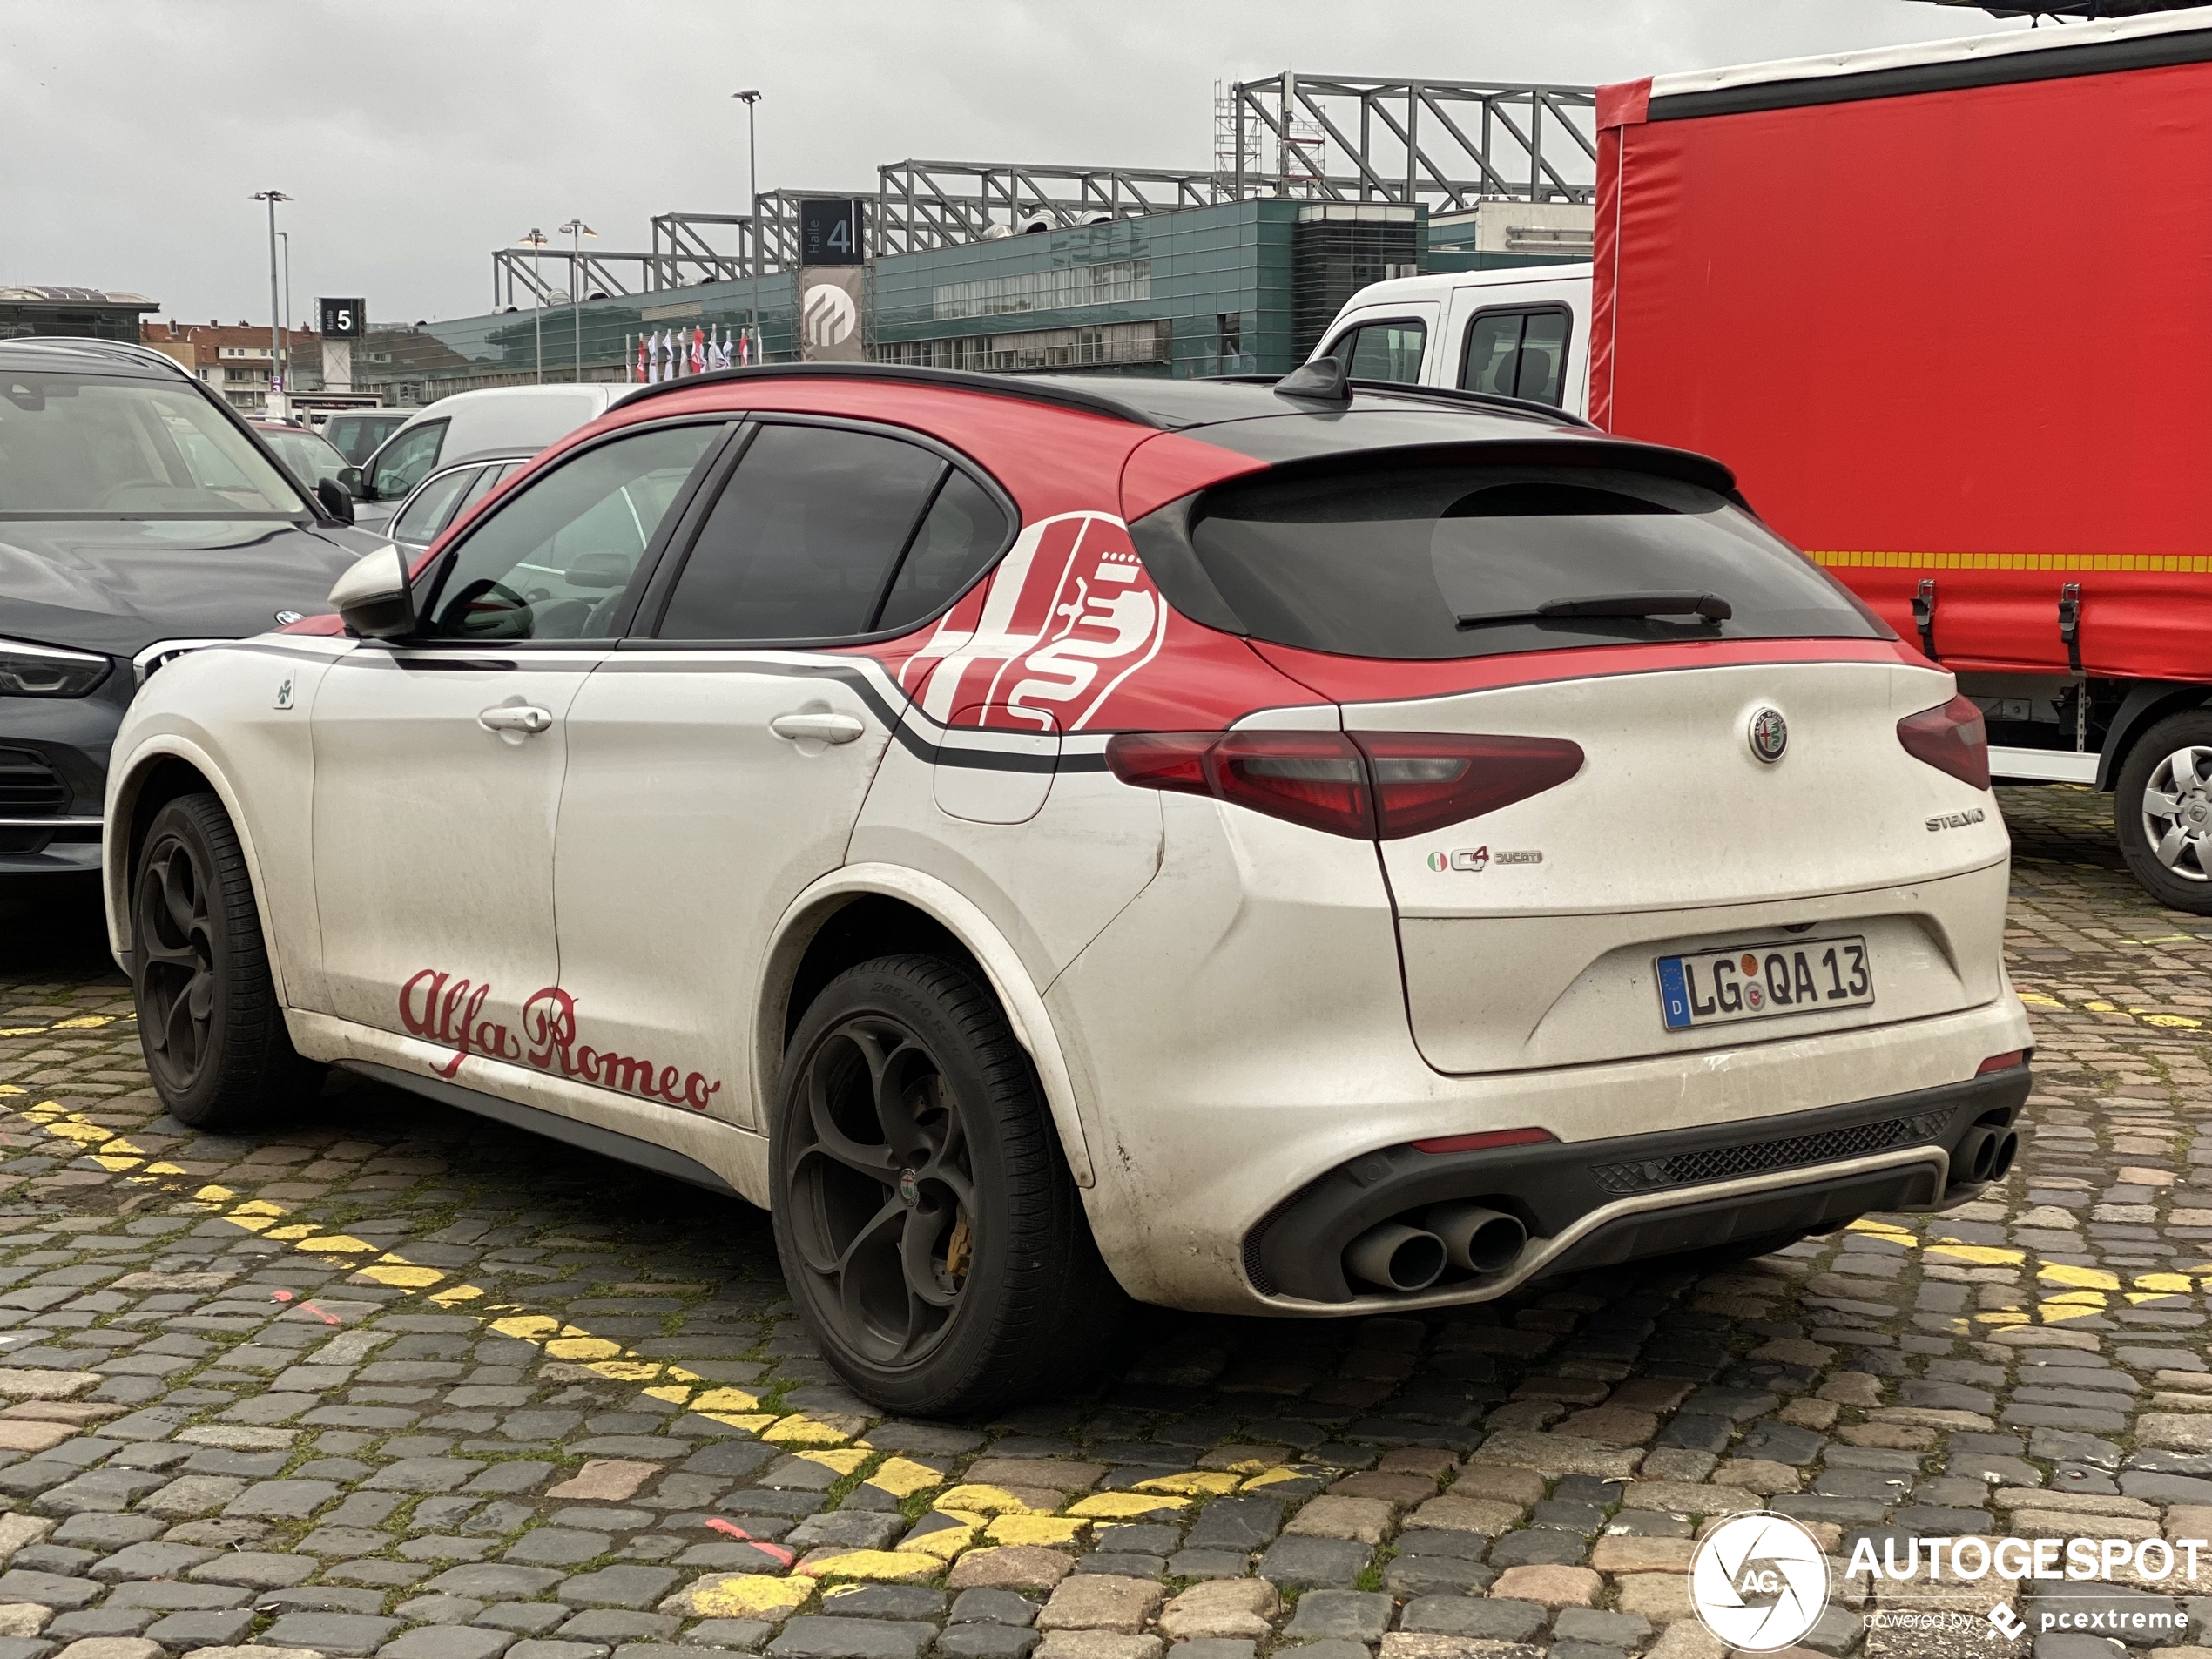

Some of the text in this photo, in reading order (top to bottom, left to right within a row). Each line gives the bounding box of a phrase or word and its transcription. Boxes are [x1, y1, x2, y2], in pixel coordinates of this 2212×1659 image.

[807, 219, 819, 253] Halle
[826, 219, 851, 253] 4
[337, 309, 351, 330] 5
[1755, 715, 1766, 736] ALFA
[1925, 807, 1986, 832] STELVIO
[1494, 851, 1543, 865] DUCATI
[1684, 945, 1869, 1016] LG QA 13
[871, 981, 933, 1018] 285/40
[1672, 1000, 1683, 1015] D
[523, 986, 721, 1110] Romeo
